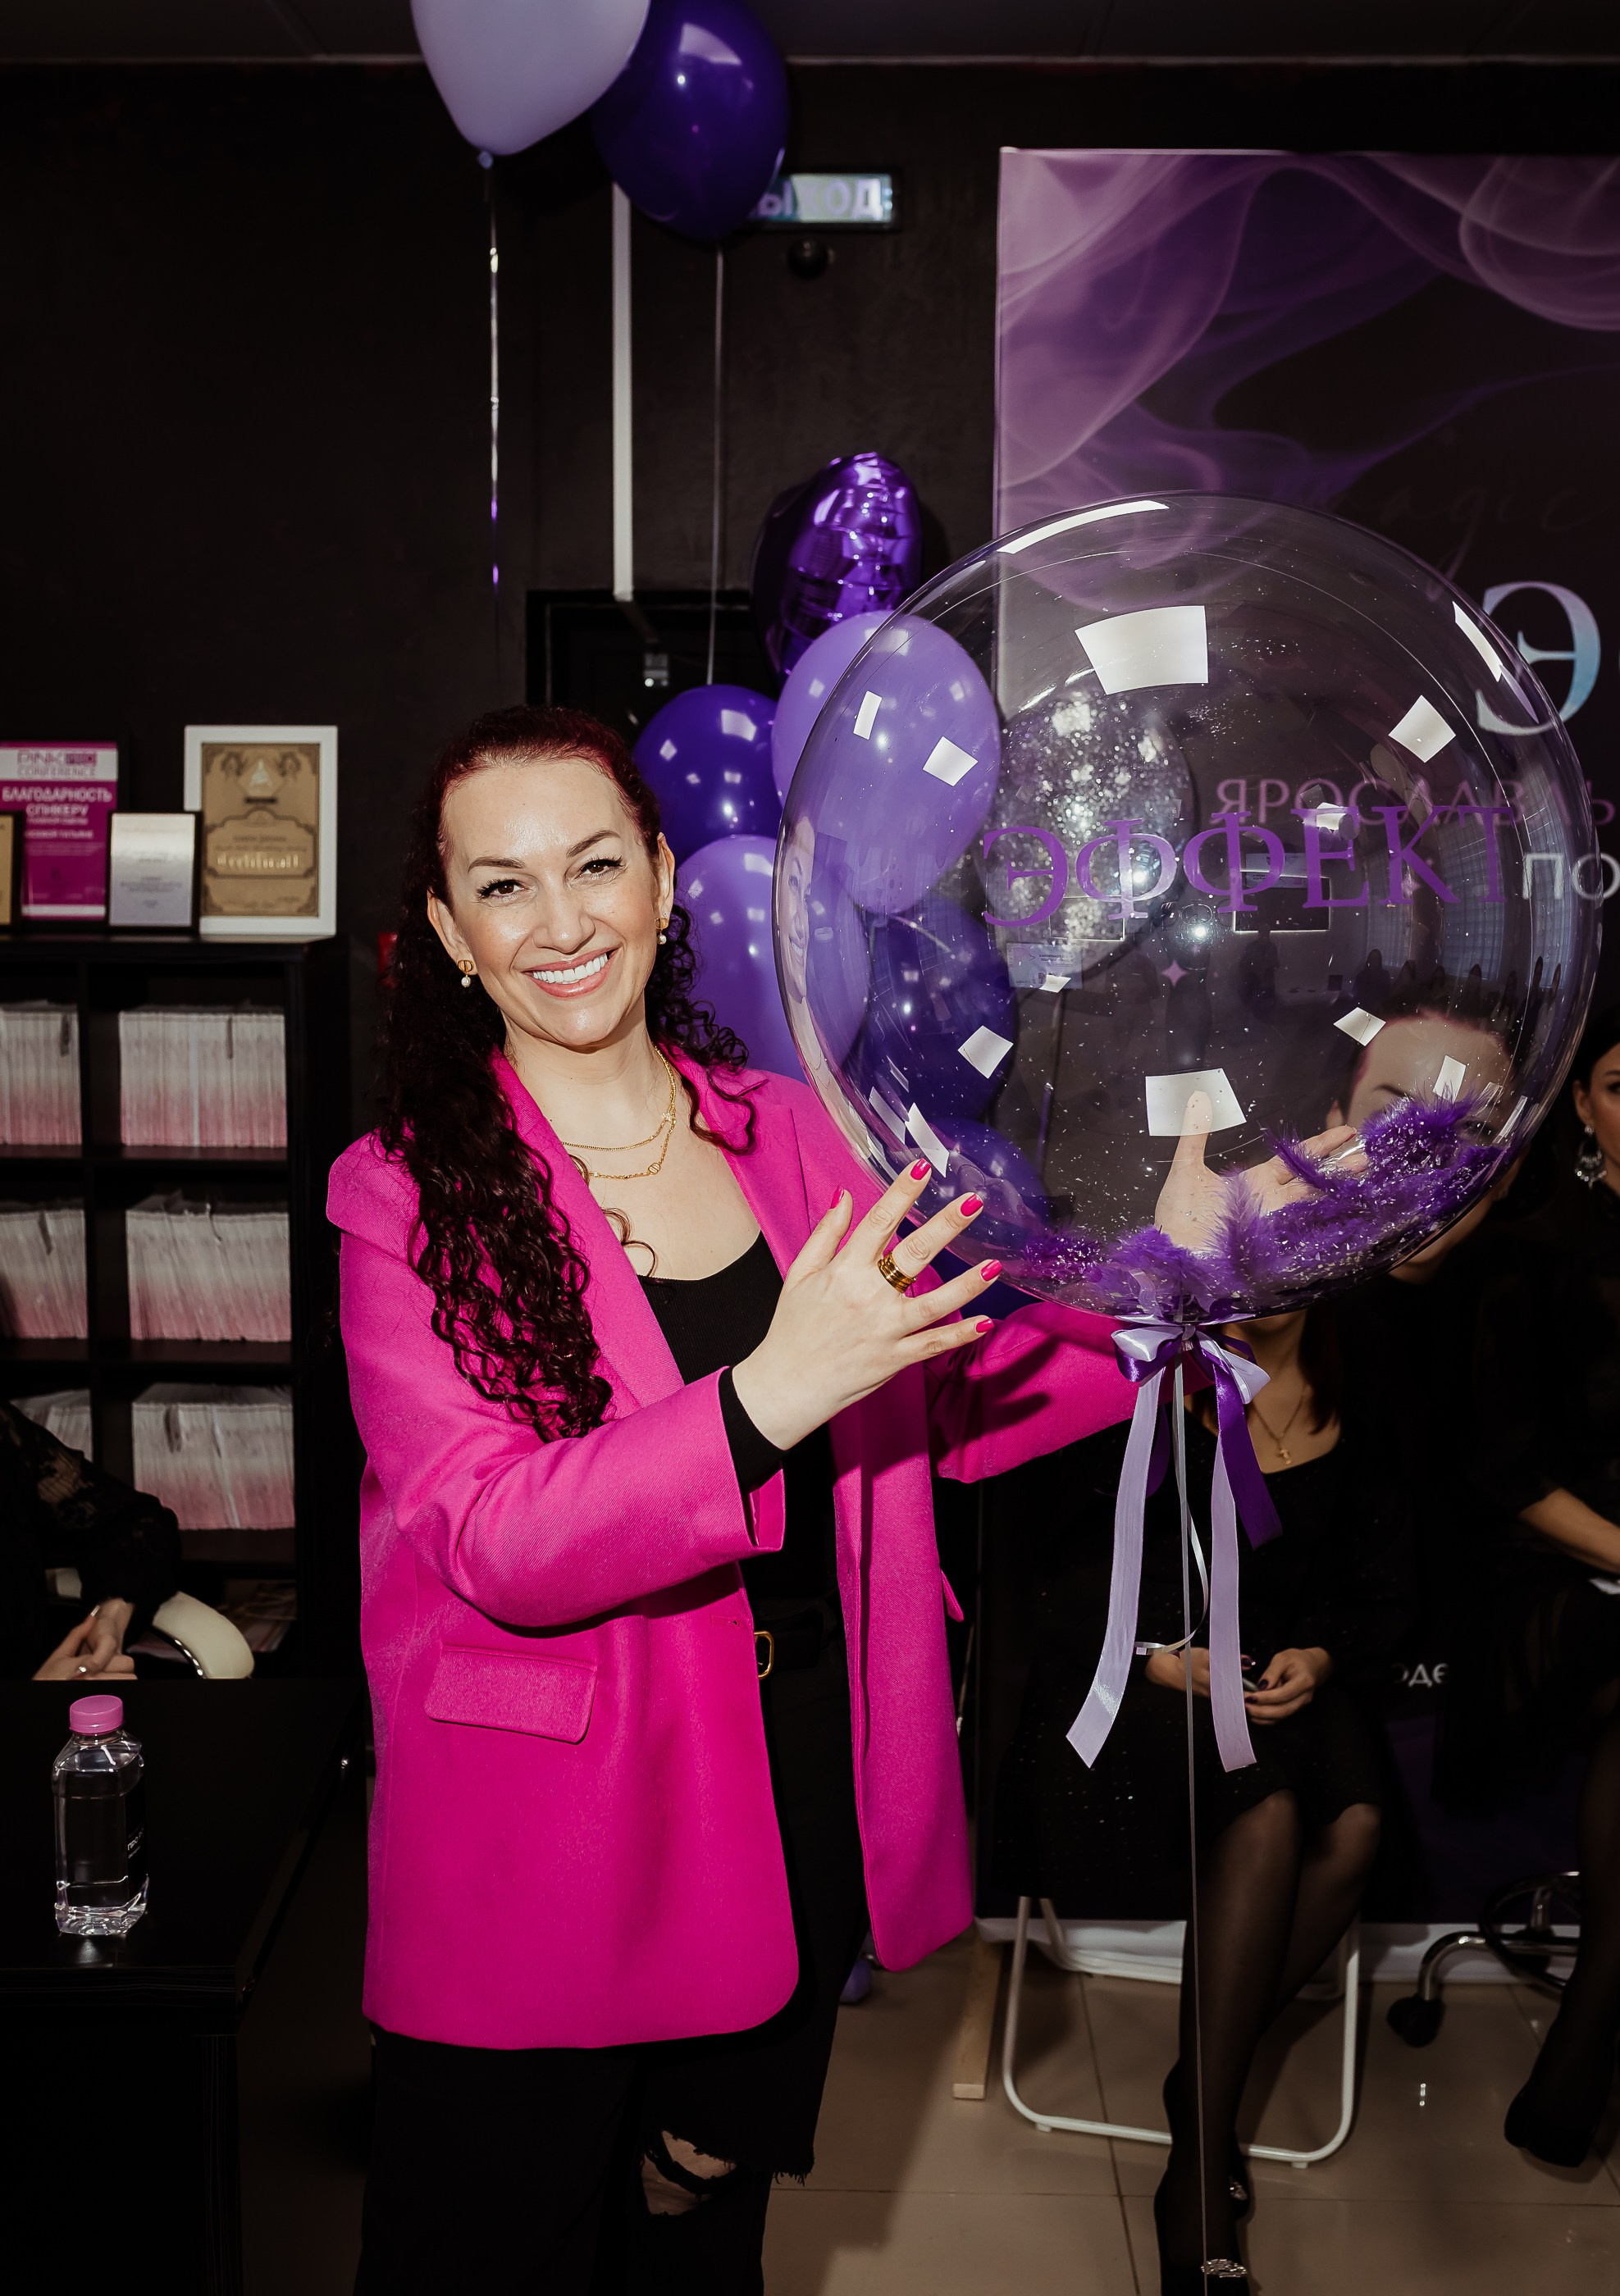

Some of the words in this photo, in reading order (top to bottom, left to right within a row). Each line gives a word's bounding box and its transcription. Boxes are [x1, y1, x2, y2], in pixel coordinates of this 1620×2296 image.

[751, 179, 884, 220] ЫХОД
[1476, 581, 1620, 736] Э
[2, 786, 112, 803] БЛАГОДАРНОСТЬ
[25, 803, 89, 817] СПИКЕРУ
[983, 806, 1514, 927] ЭФФЕКТ
